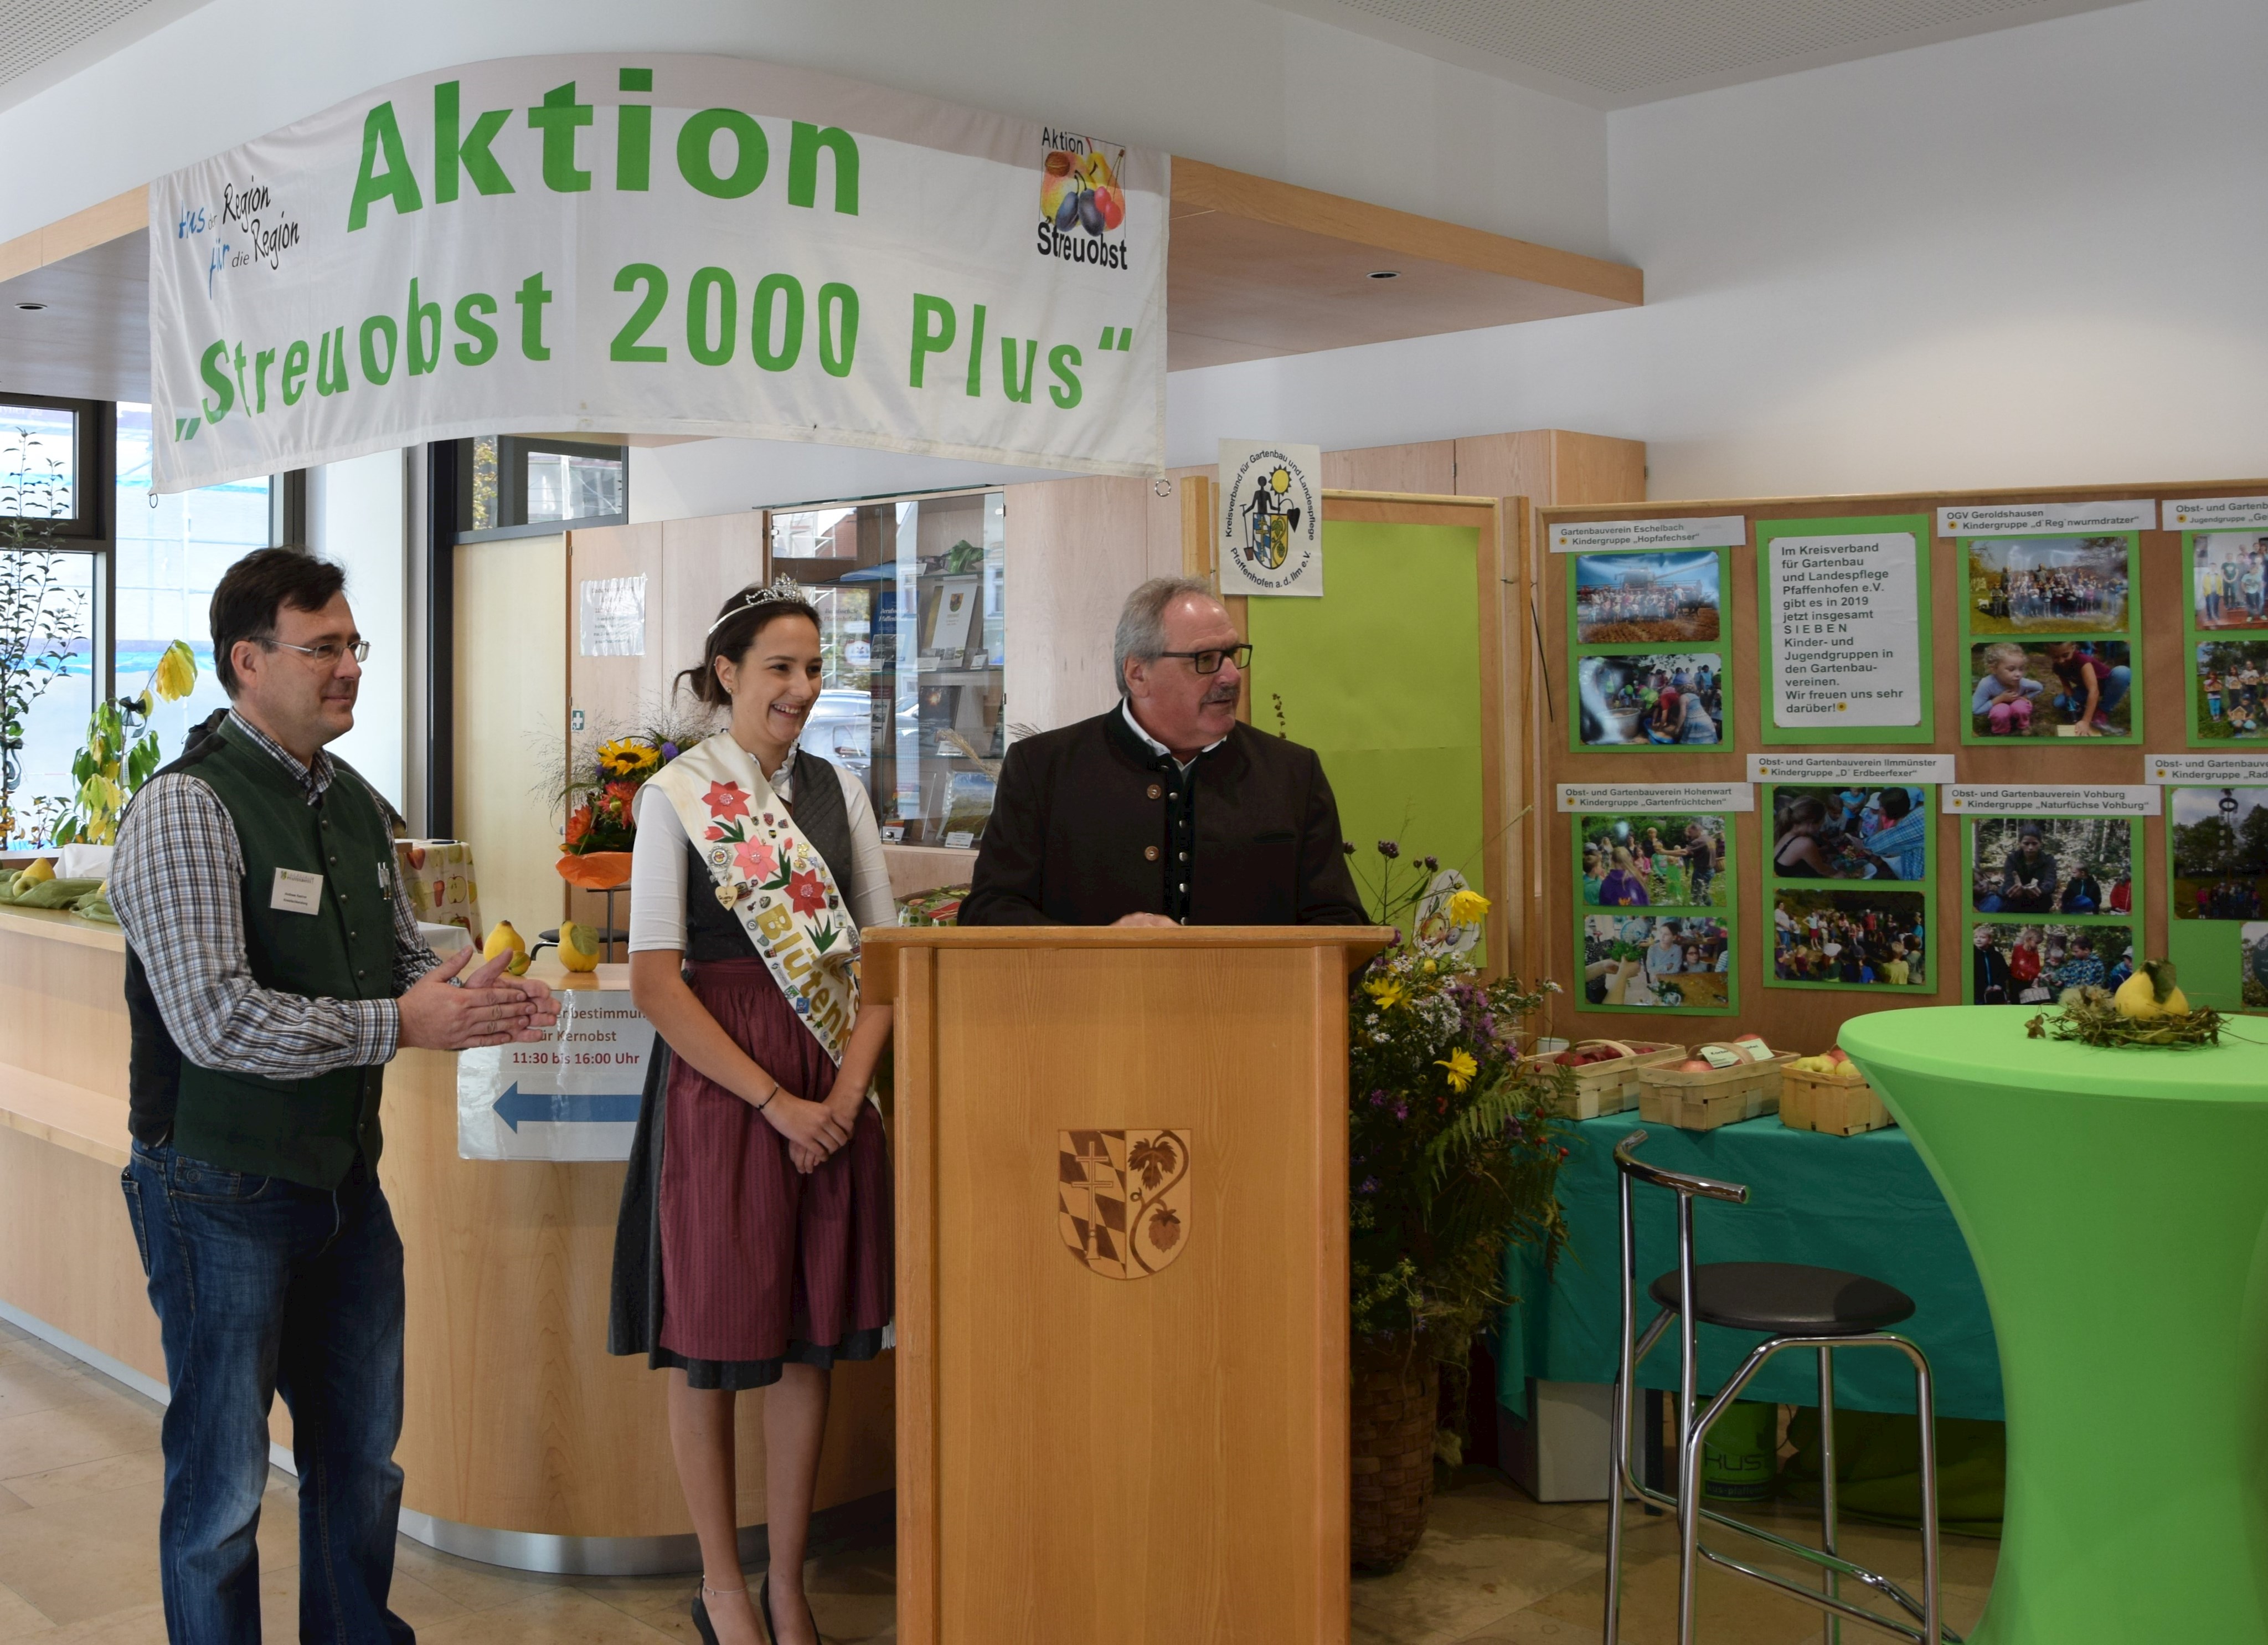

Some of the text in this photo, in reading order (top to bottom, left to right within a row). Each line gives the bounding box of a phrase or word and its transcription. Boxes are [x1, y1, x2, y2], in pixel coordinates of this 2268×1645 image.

[1042, 126, 1084, 156] Aktion
[347, 68, 859, 233] Aktion
[223, 175, 271, 233] Region
[1037, 222, 1128, 270] Streuobst
[209, 211, 300, 300] für die Region
[175, 263, 1133, 443] „Streuobst 2000 Plus“
[1225, 450, 1316, 541] Kreisverband für Gartenbau und Landespflege
[2176, 502, 2268, 513] Obst- und Gartenb
[1947, 510, 2044, 520] OGV Geroldshausen
[2249, 513, 2268, 522] „Ge
[1561, 524, 1684, 536] Gartenbauverein Eschelbach
[1963, 521, 2028, 531] Kindergruppe
[1573, 536, 1631, 546] Kindergruppe
[1782, 543, 1879, 556] Im Kreisverband
[1230, 547, 1274, 588] Pfaffenhofen
[1284, 577, 1291, 586] d.
[1291, 567, 1303, 580] Ilm
[1782, 558, 1864, 569] für Gartenbau
[1782, 570, 1889, 582] und Landespflege
[1783, 582, 1884, 595] Pfaffenhofen e.V.
[1783, 599, 1806, 610] gibt
[1827, 597, 1837, 606] in
[1841, 596, 1869, 606] 2019
[1783, 610, 1874, 624] jetzt insgesamt
[1785, 637, 1854, 647] Kinder- und
[1785, 649, 1893, 662] Jugendgruppen in
[1785, 664, 1878, 674] den Gartenbau-
[1785, 677, 1839, 687] vereinen.
[1786, 691, 1806, 700] Wir
[1809, 690, 1847, 700] freuen
[1877, 689, 1903, 698] sehr
[1786, 703, 1836, 713] darüber!
[1759, 758, 1784, 766] Obst-
[1806, 758, 1882, 767] Gartenbauverein
[2155, 759, 2182, 768] Obst-
[2207, 759, 2268, 768] Gartenbauve
[1771, 768, 1833, 778] Kindergruppe
[2172, 770, 2268, 780] Kindergruppe „Rad
[1565, 788, 1589, 796] Obst-
[1610, 788, 1682, 796] Gartenbauverein
[1951, 789, 2125, 800] Obst- und Gartenbauverein Vohburg
[1580, 798, 1638, 808] Kindergruppe
[1967, 800, 2033, 810] Kindergruppe
[557, 1030, 617, 1041] Kernobst
[513, 1052, 640, 1064] 11:30 bis 16:00 Uhr
